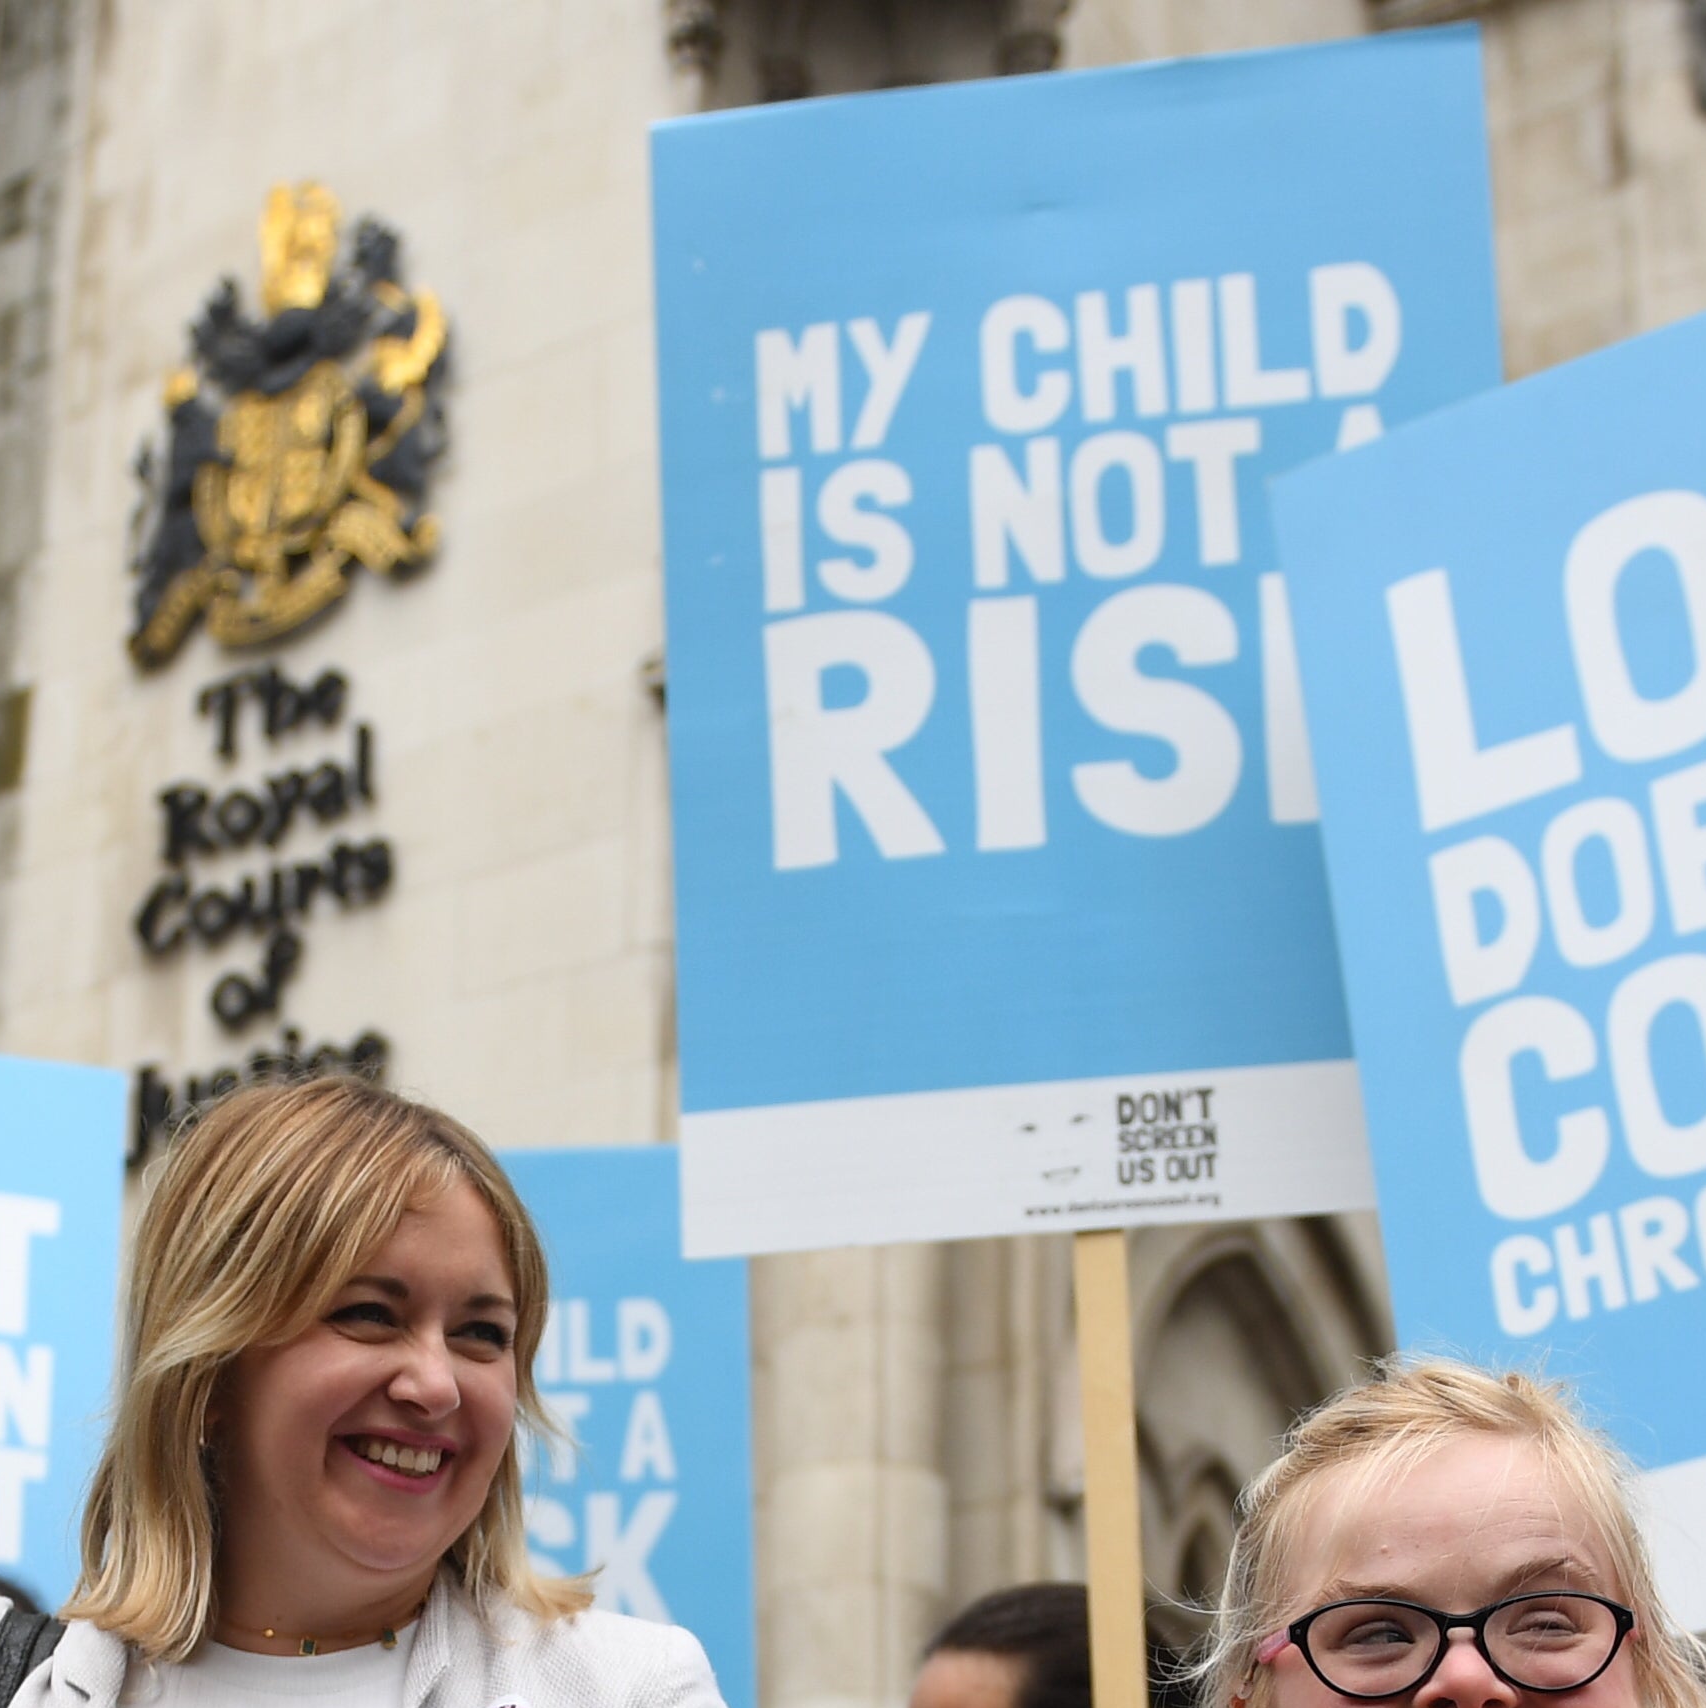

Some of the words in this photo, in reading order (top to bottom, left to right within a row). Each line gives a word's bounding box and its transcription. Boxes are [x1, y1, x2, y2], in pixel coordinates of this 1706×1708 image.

[754, 309, 933, 462] MY
[979, 259, 1404, 436] CHILD
[759, 457, 915, 615] IS
[969, 415, 1263, 591] NOT
[198, 661, 349, 762] The
[159, 721, 376, 866] Royal
[136, 839, 392, 956] Courts
[211, 930, 301, 1029] of
[1117, 1087, 1214, 1125] DON'T
[1117, 1124, 1217, 1152] SCREEN
[1117, 1157, 1155, 1185] US
[1165, 1153, 1216, 1182] OUT
[619, 1390, 677, 1482] A
